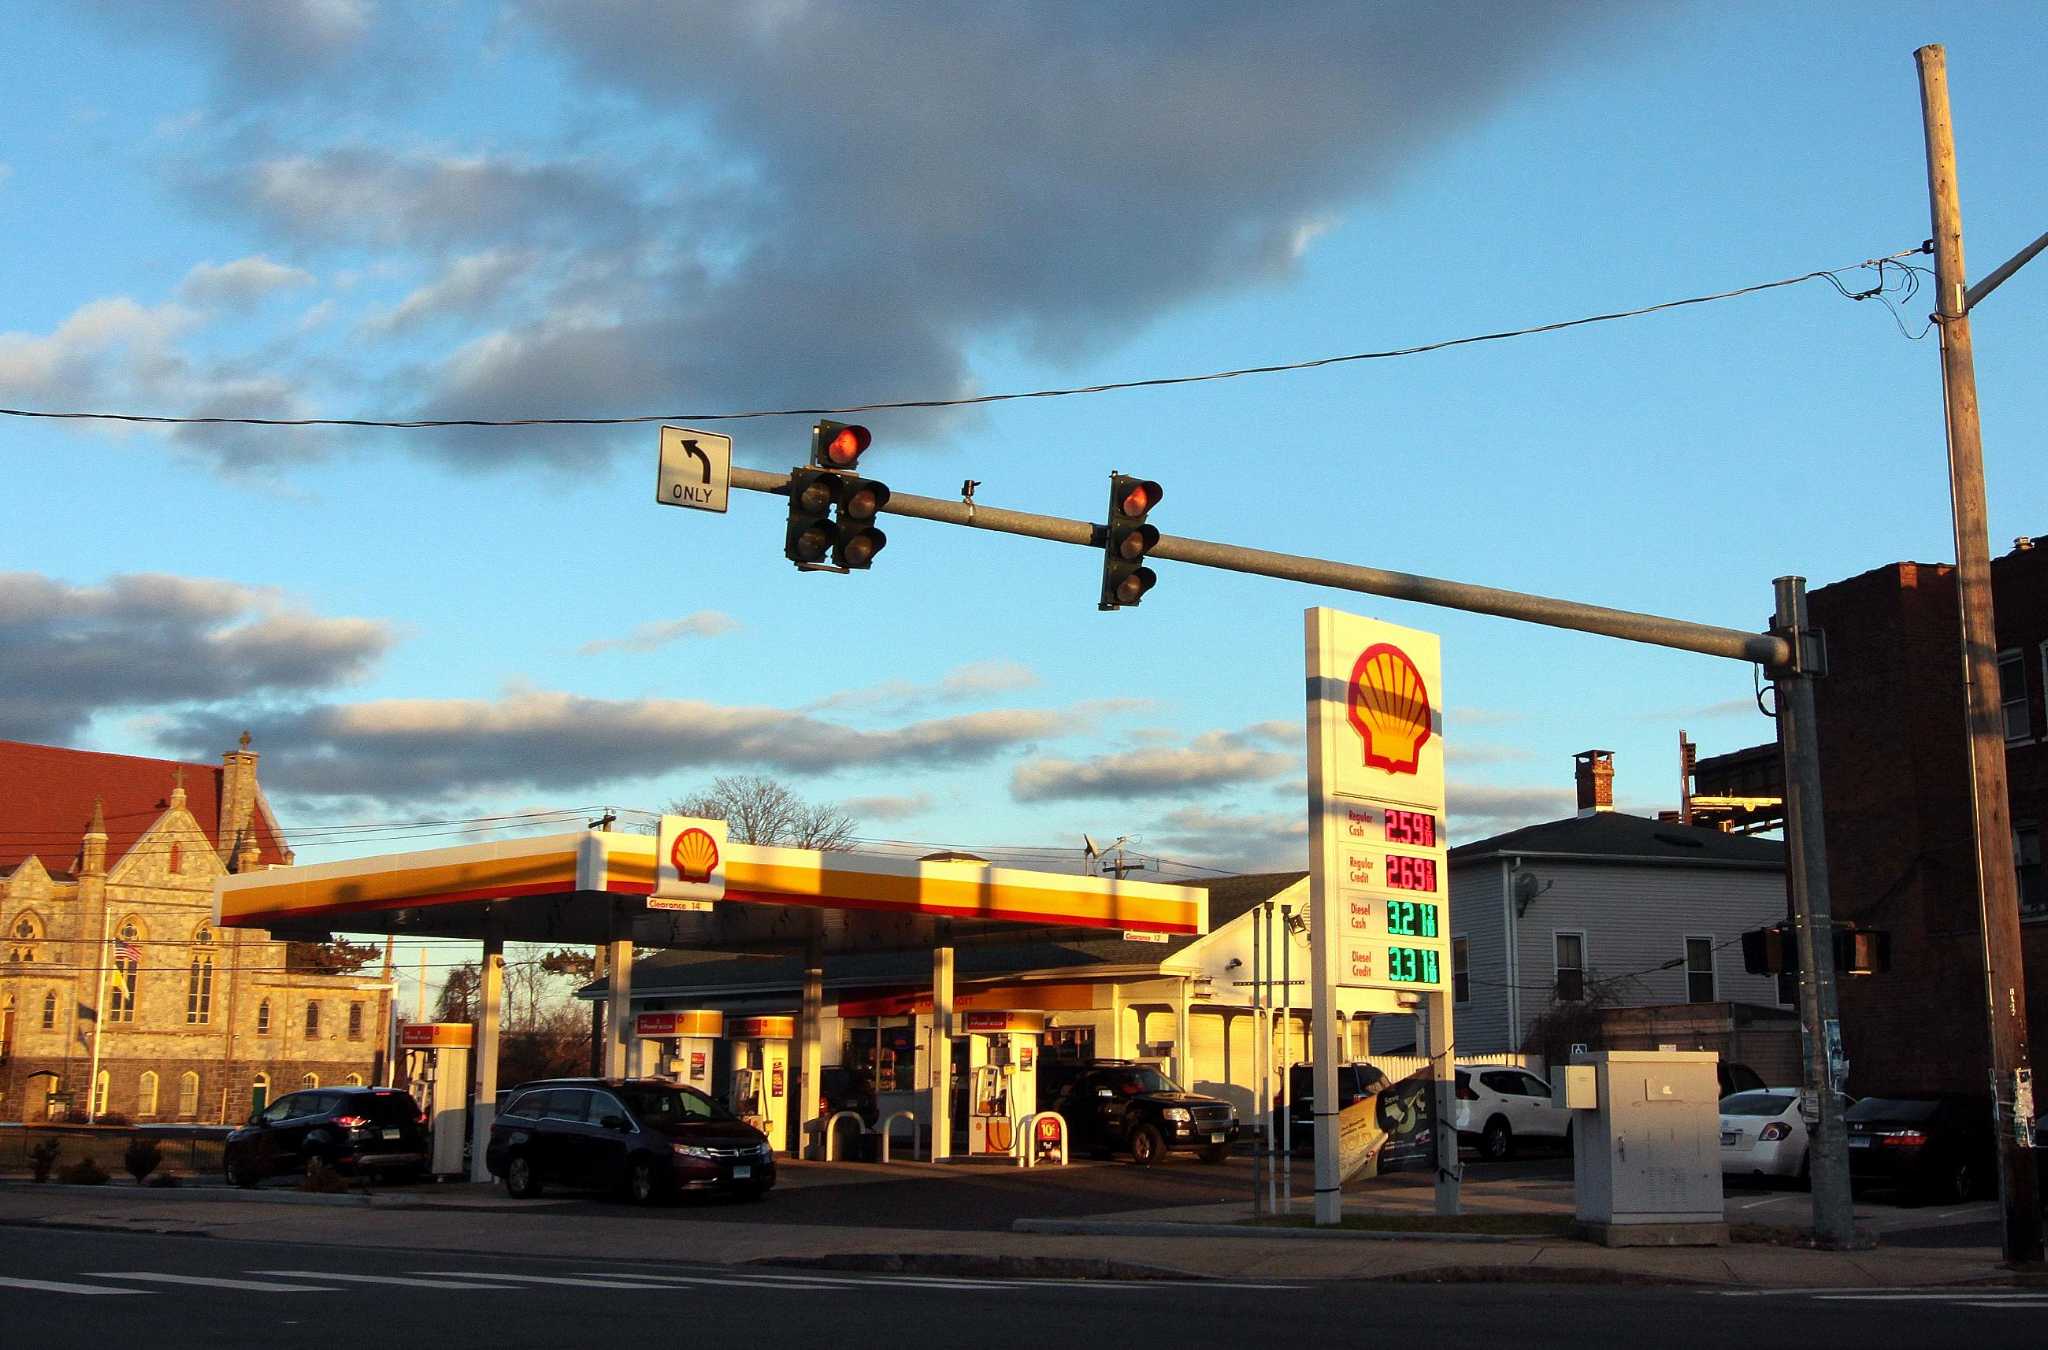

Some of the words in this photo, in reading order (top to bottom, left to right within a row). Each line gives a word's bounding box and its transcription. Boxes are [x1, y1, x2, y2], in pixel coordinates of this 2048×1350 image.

[673, 484, 713, 503] ONLY
[1349, 810, 1373, 825] Regular
[1349, 825, 1364, 837] Cash
[1350, 856, 1374, 871] Regular
[1350, 871, 1369, 884] Credit
[649, 900, 687, 909] Clearance
[1350, 903, 1371, 916] Diesel
[1351, 917, 1367, 929] Cash
[1352, 950, 1372, 963] Diesel
[1352, 964, 1372, 977] Credit
